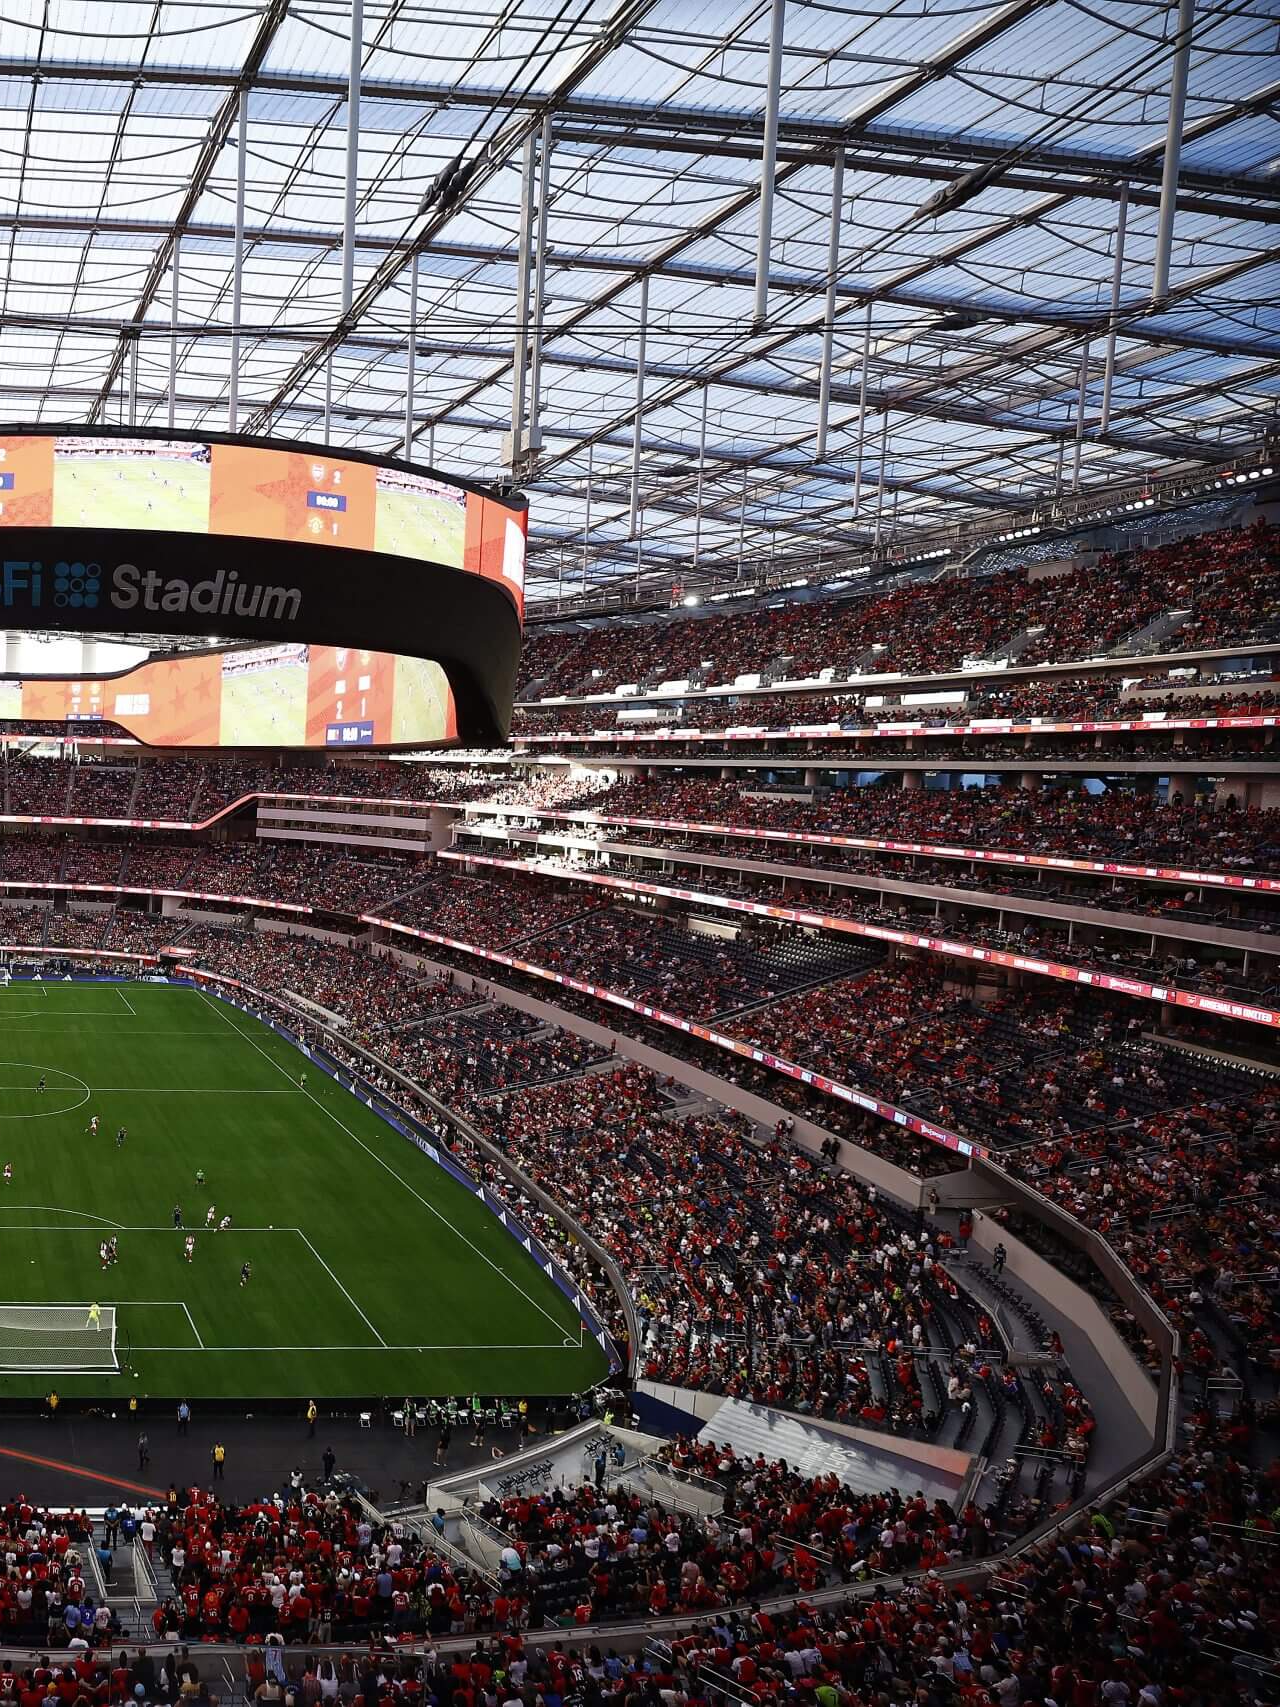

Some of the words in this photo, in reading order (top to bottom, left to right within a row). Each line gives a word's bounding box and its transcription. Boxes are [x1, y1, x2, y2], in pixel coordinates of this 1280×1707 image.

[111, 563, 302, 621] Stadium
[336, 700, 343, 719] 2
[1199, 998, 1231, 1013] ARSENAL
[1231, 1005, 1242, 1016] VS
[1242, 1008, 1273, 1023] UNITED
[1, 1679, 14, 1689] 37
